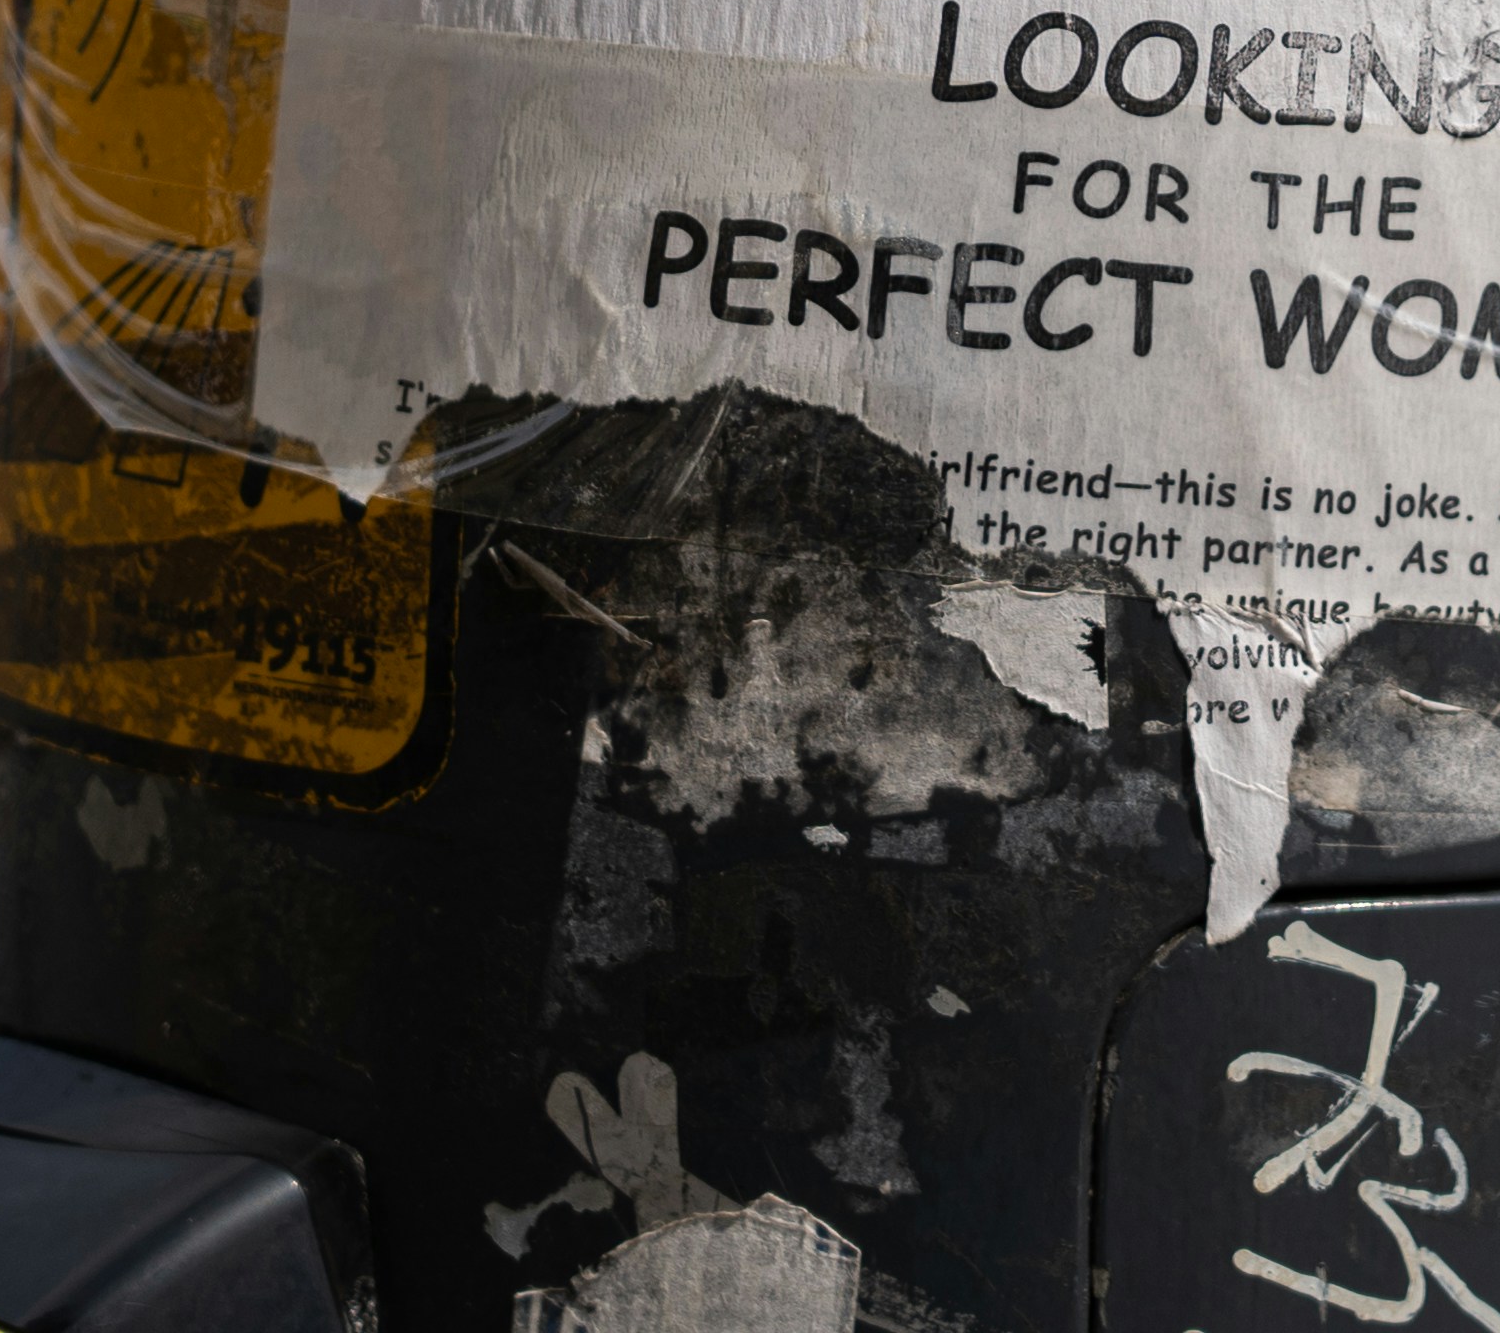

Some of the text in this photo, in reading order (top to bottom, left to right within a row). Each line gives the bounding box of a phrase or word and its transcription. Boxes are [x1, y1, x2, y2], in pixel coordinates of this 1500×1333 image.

[1013, 152, 1422, 242] FOR THE
[643, 210, 1194, 357] PERFECT
[976, 508, 1048, 548] the
[1071, 520, 1182, 566] right
[1202, 533, 1374, 573] partner.
[1399, 540, 1449, 576] As
[1468, 549, 1490, 577] a
[1261, 476, 1293, 512] is
[1313, 486, 1357, 516] no
[1375, 482, 1474, 528] joke.
[235, 604, 377, 685] 19115
